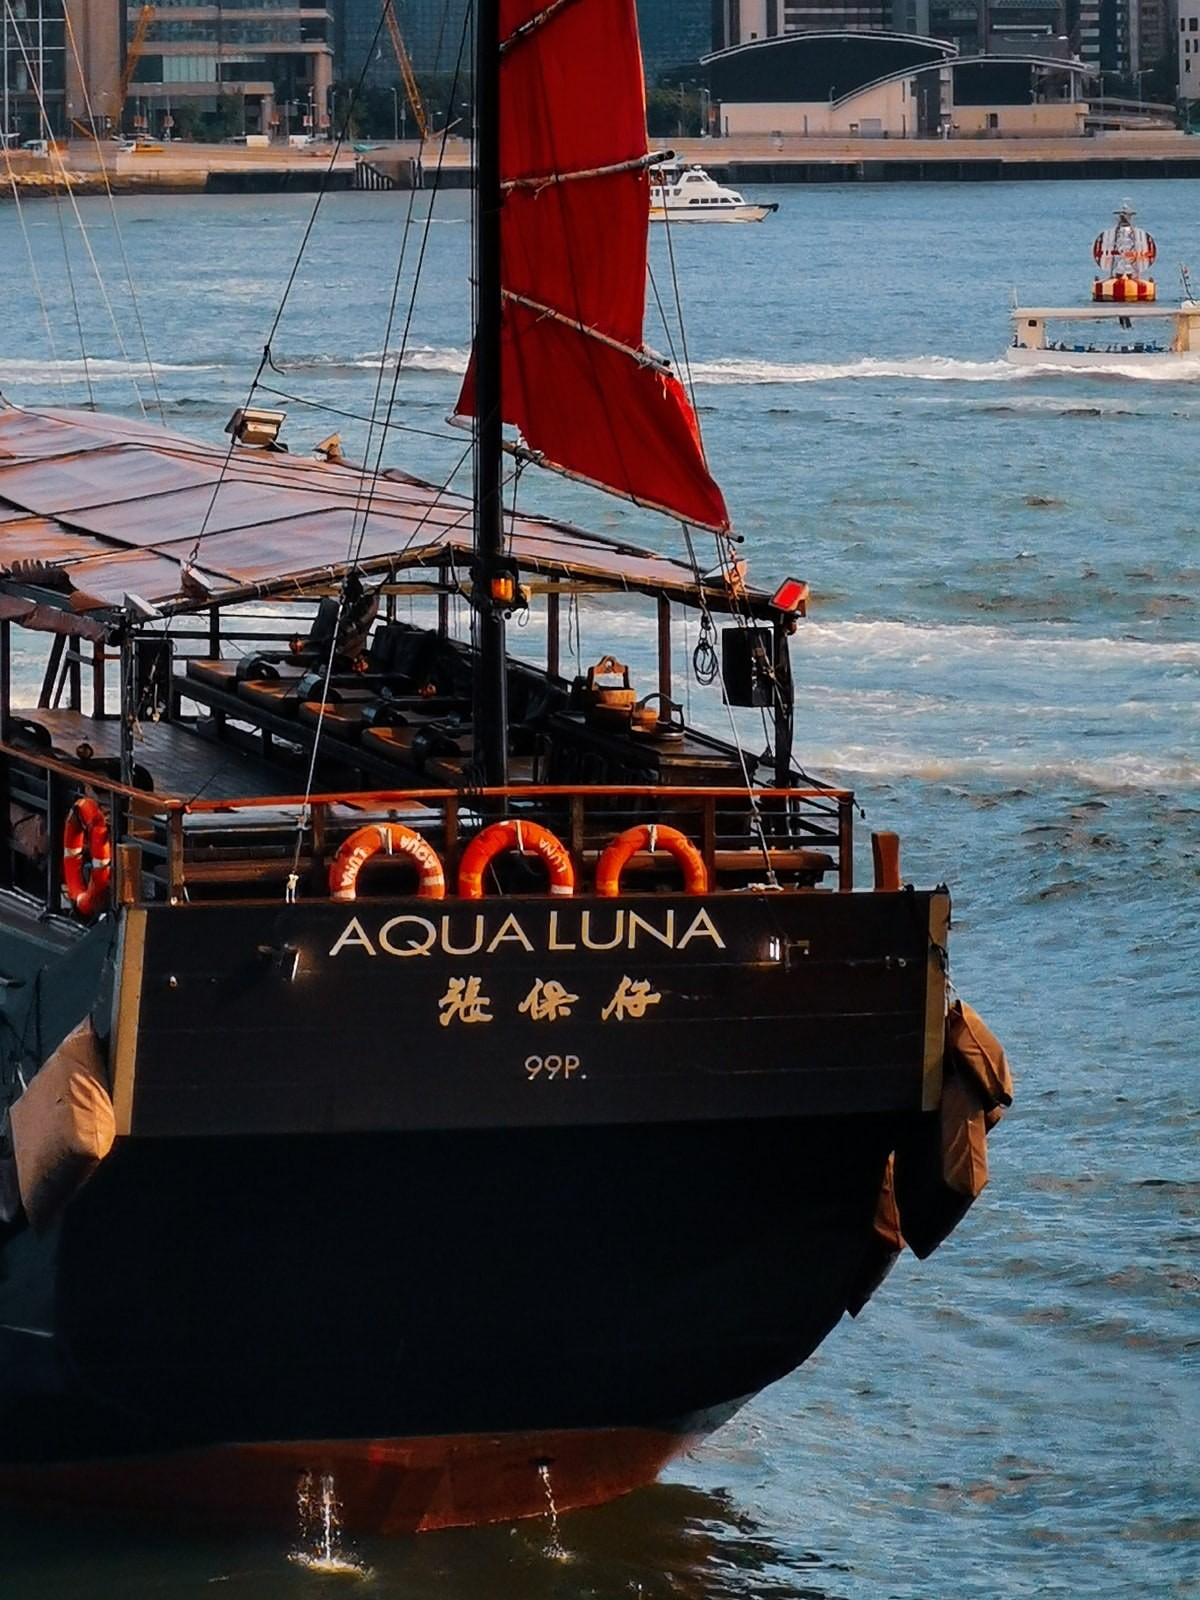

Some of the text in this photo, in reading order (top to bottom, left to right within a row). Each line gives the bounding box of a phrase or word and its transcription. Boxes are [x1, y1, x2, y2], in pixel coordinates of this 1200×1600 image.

[340, 846, 368, 887] LUNA
[539, 838, 567, 873] LUNA
[329, 907, 726, 957] AQUA LUNA
[438, 975, 661, 1027] 張保仔
[524, 1055, 588, 1081] 99P.
